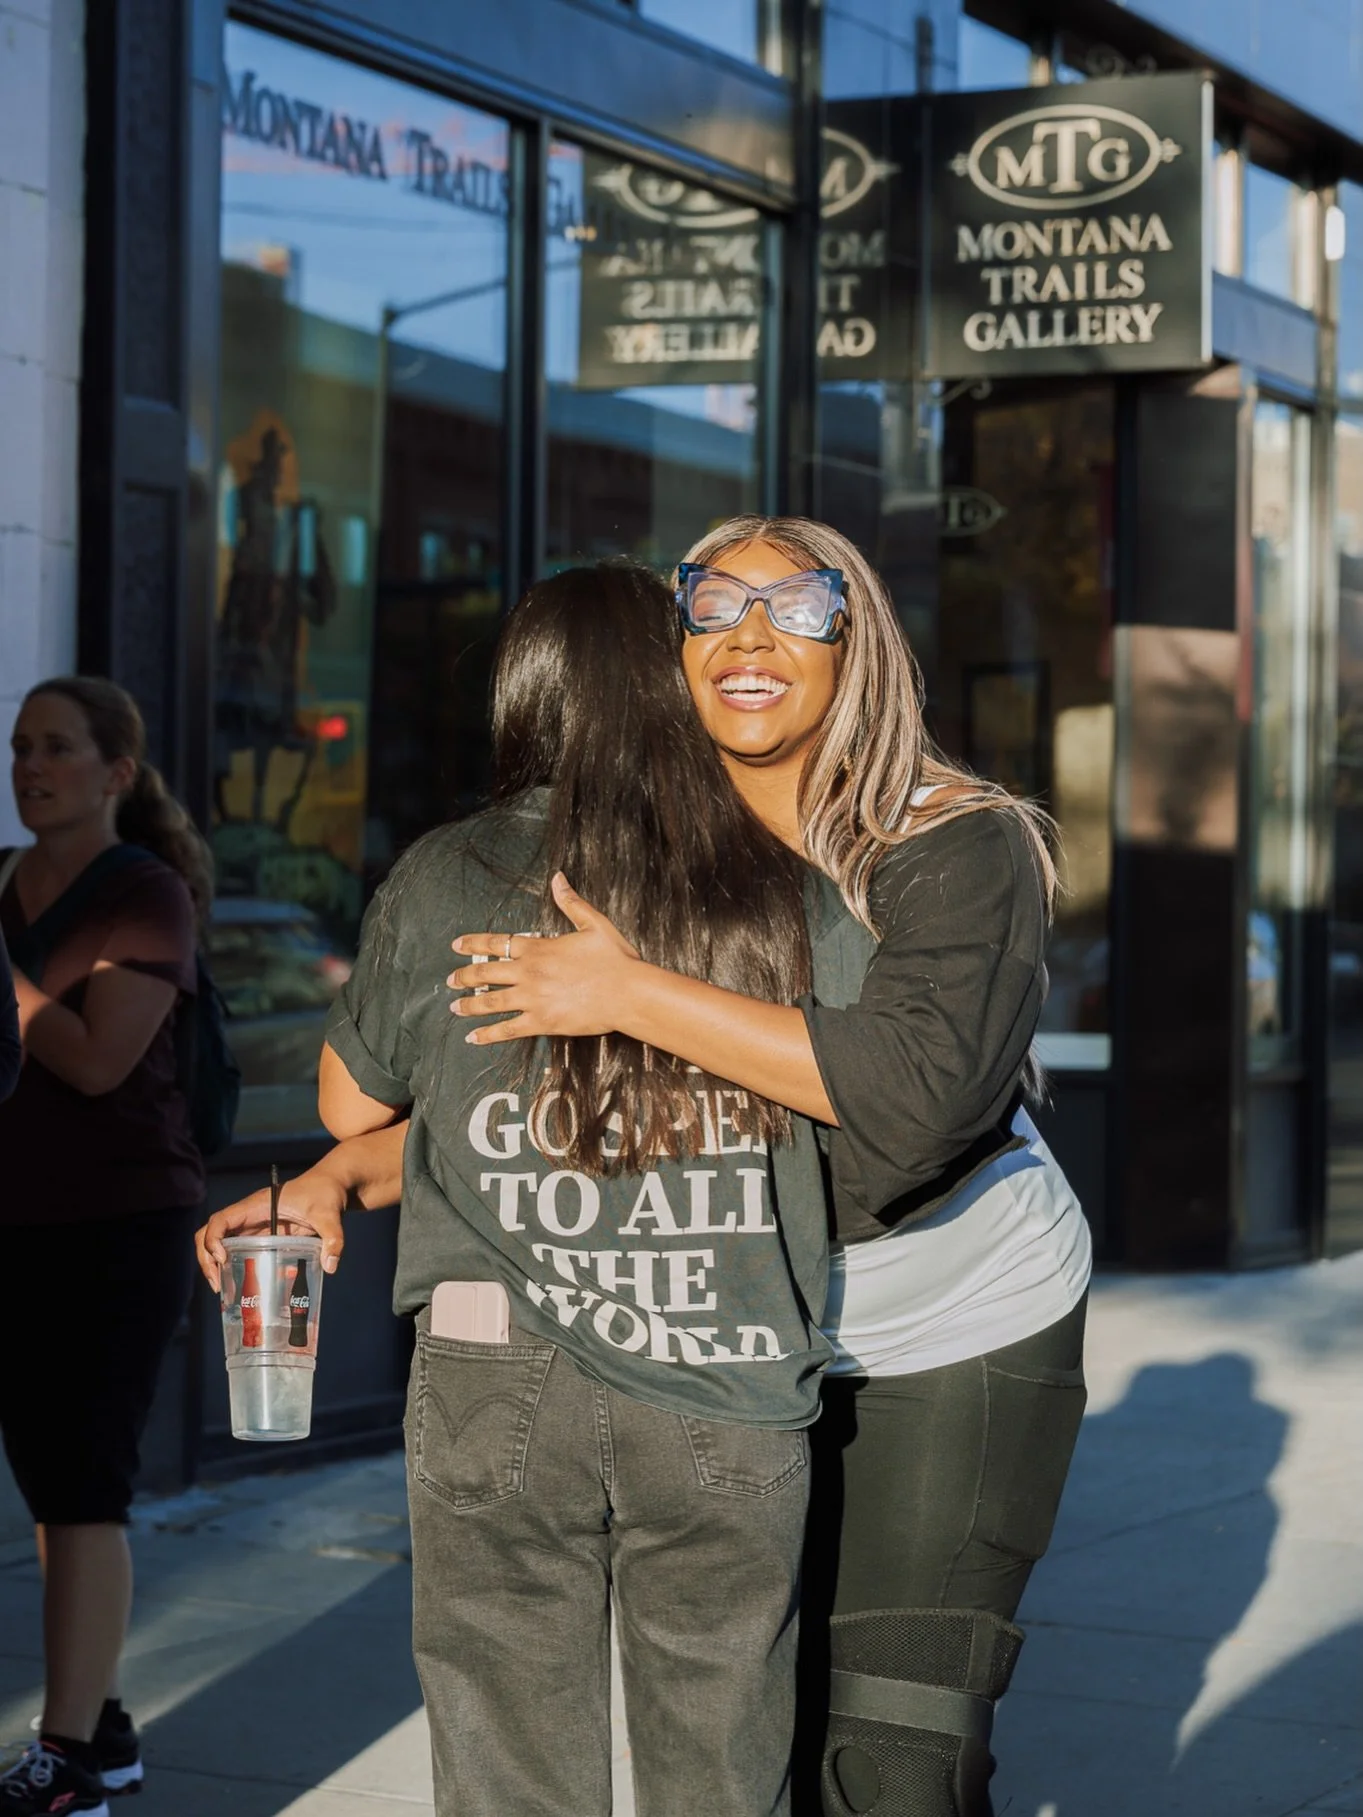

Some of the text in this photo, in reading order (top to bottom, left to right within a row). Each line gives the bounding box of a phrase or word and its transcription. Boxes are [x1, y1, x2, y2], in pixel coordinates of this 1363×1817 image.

[222, 60, 389, 183] MONTANA
[993, 117, 1132, 194] MTG
[956, 212, 1174, 263] MONTANA
[979, 258, 1147, 306] TRAILS
[962, 302, 1164, 353] GALLERY
[467, 1090, 769, 1160] GOSPE
[479, 1167, 778, 1237] TO ALL
[530, 1242, 718, 1314] THE
